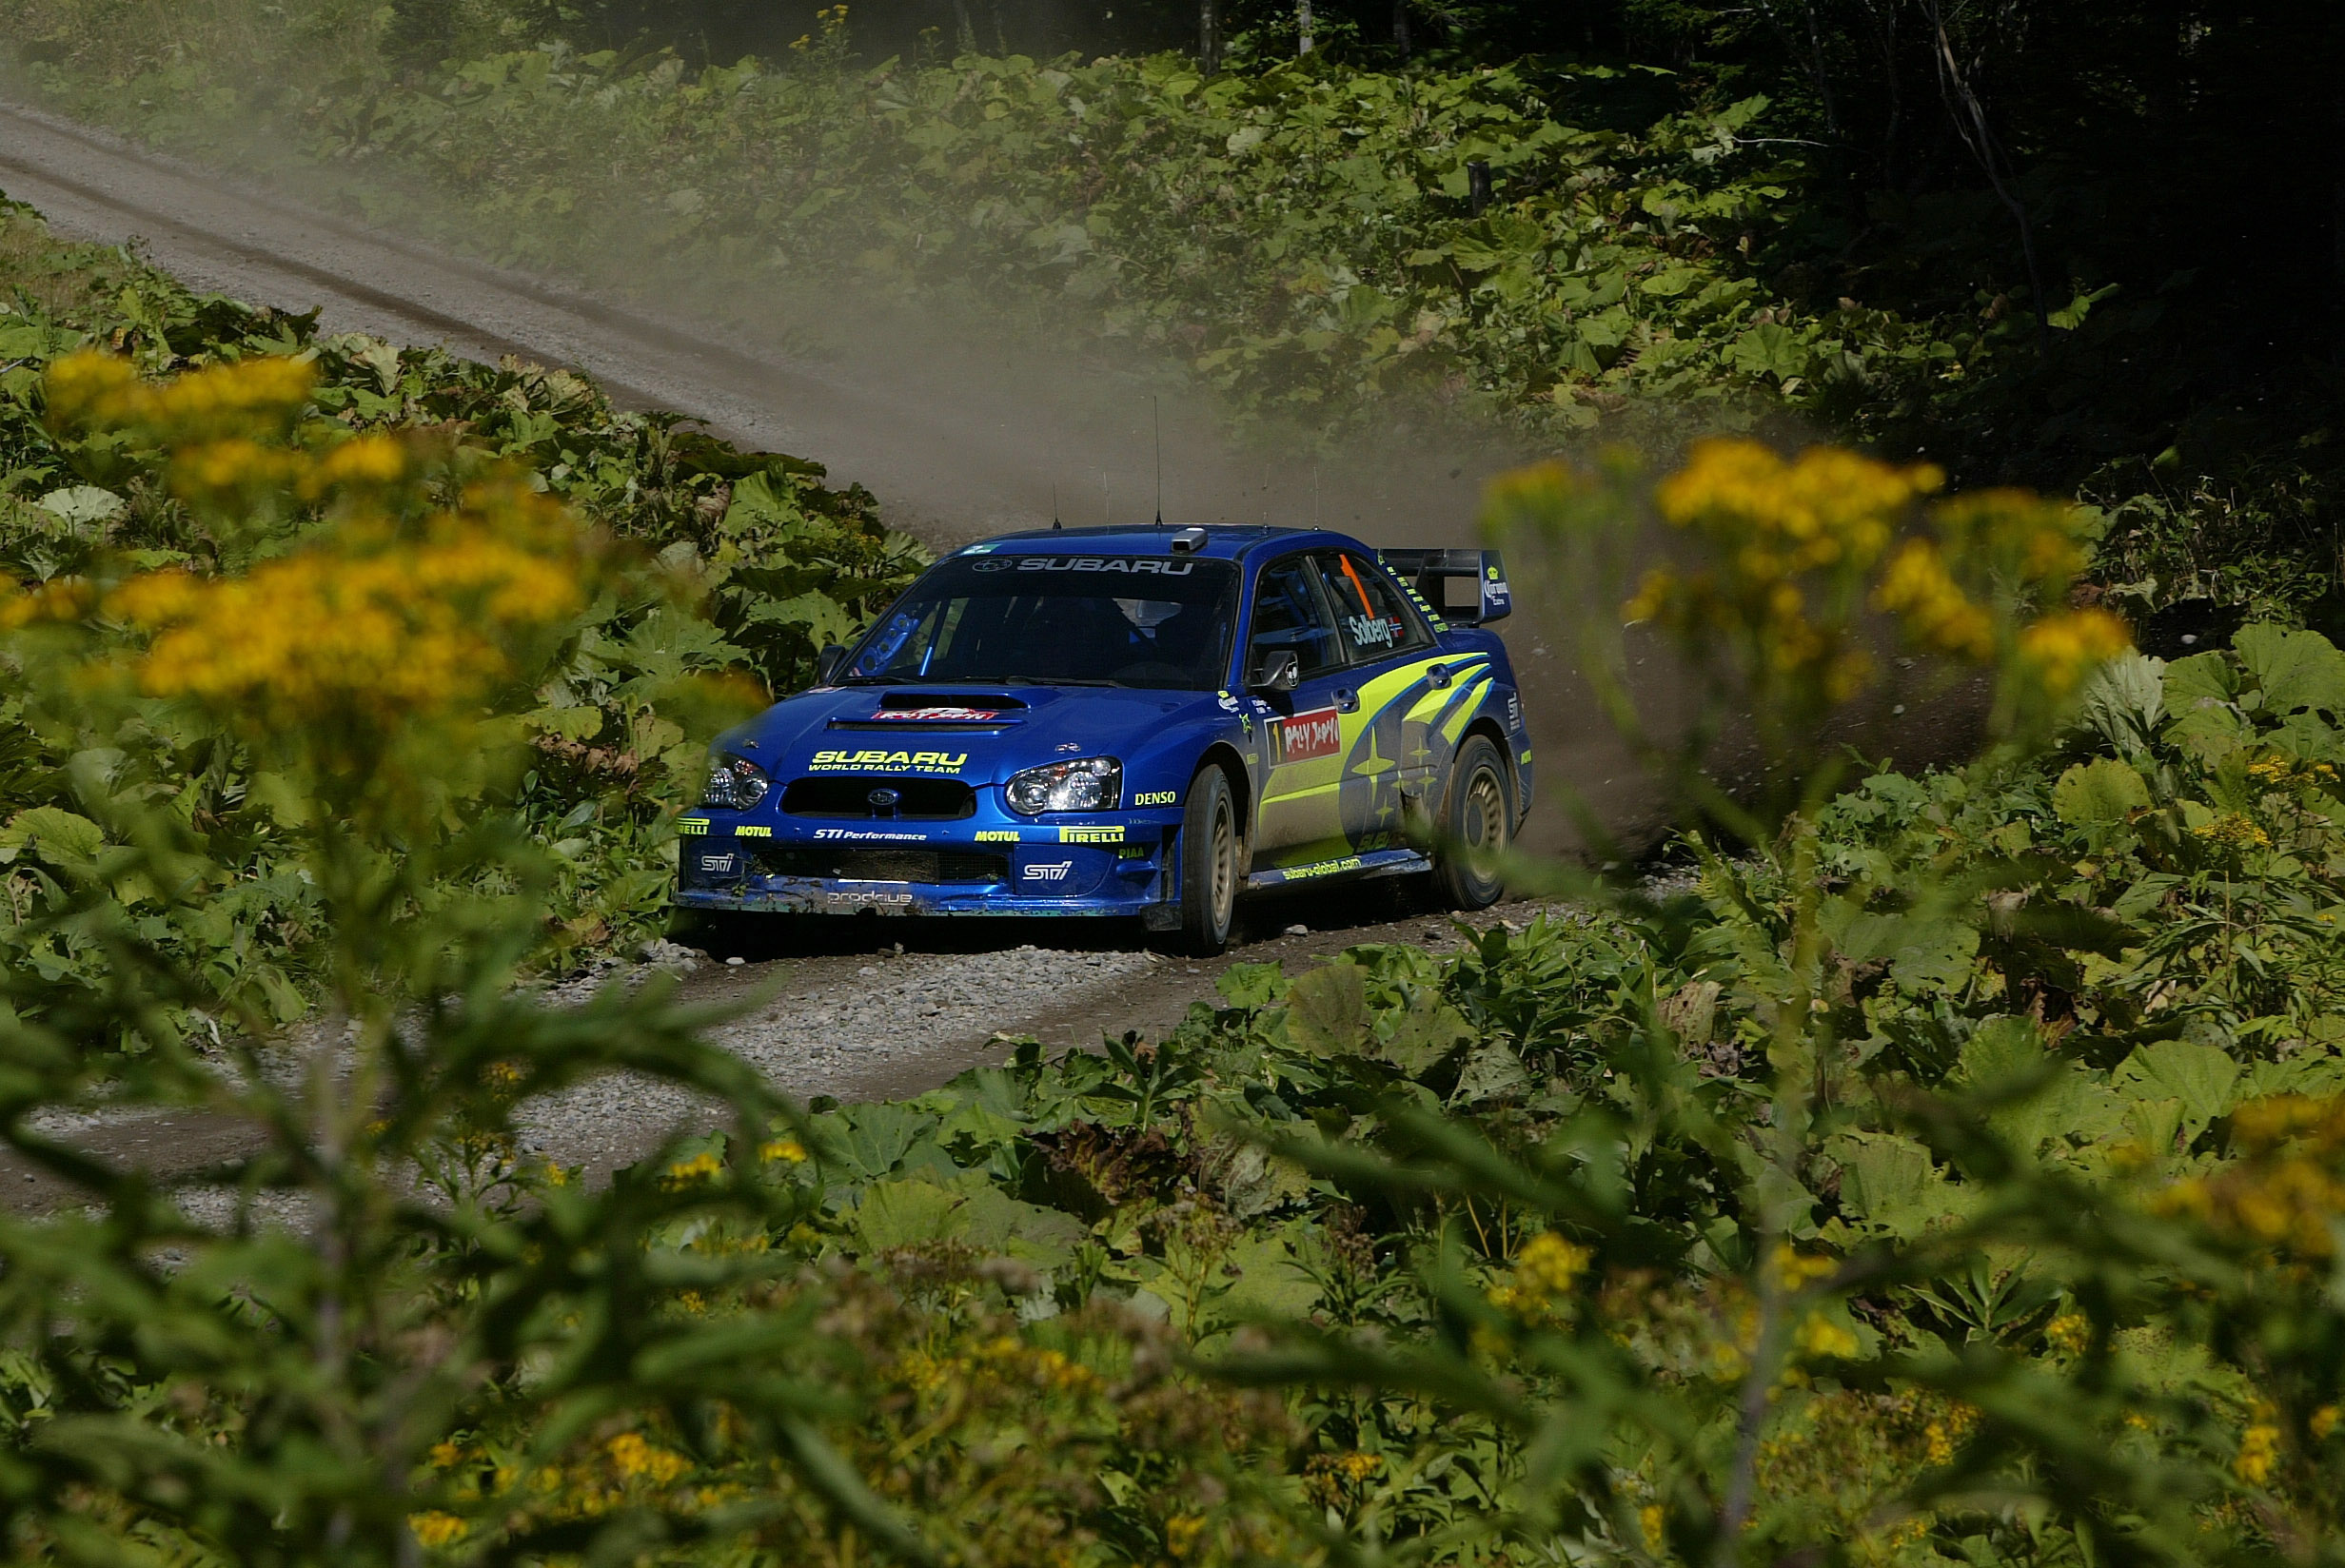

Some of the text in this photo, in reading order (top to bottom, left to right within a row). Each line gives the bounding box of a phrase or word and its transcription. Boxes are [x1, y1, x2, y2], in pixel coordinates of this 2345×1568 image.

[1017, 558, 1193, 576] SUBARU
[1339, 554, 1376, 620] 1
[1349, 614, 1392, 648] Solberg
[1272, 723, 1281, 762] 1
[812, 750, 968, 766] SUBARU
[915, 765, 961, 774] TEAM
[1134, 791, 1176, 806] DENSO
[735, 825, 772, 837] MOTUL
[843, 832, 927, 841] Performance
[974, 831, 1021, 842] MOTUL
[1058, 825, 1125, 843] PIRELLI
[1118, 847, 1145, 859] PIAA
[1282, 858, 1362, 880] subaru-global.com
